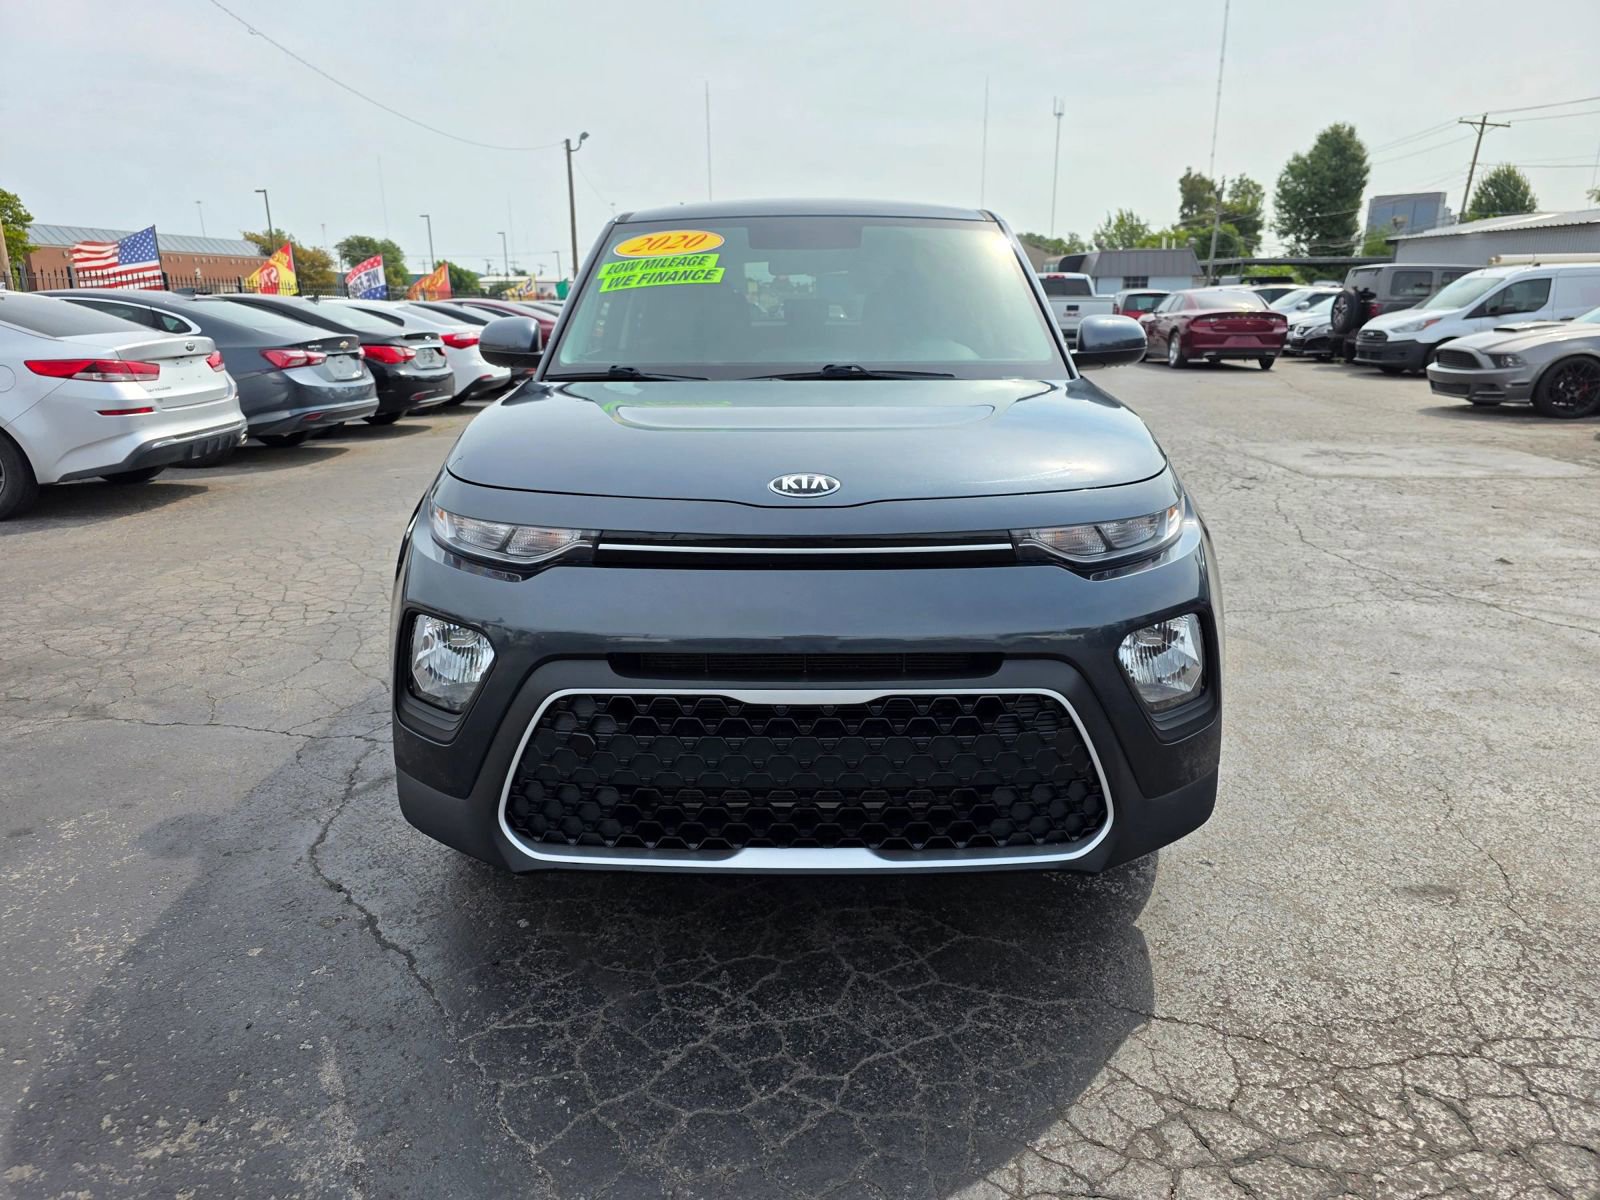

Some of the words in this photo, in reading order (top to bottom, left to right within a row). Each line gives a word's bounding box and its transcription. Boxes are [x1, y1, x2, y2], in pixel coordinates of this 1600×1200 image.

[628, 234, 708, 253] 2020
[607, 259, 642, 275] LOW
[640, 255, 711, 270] MILEAGE
[607, 274, 637, 288] WE
[636, 269, 719, 285] FINANCE
[781, 475, 829, 490] KIA
